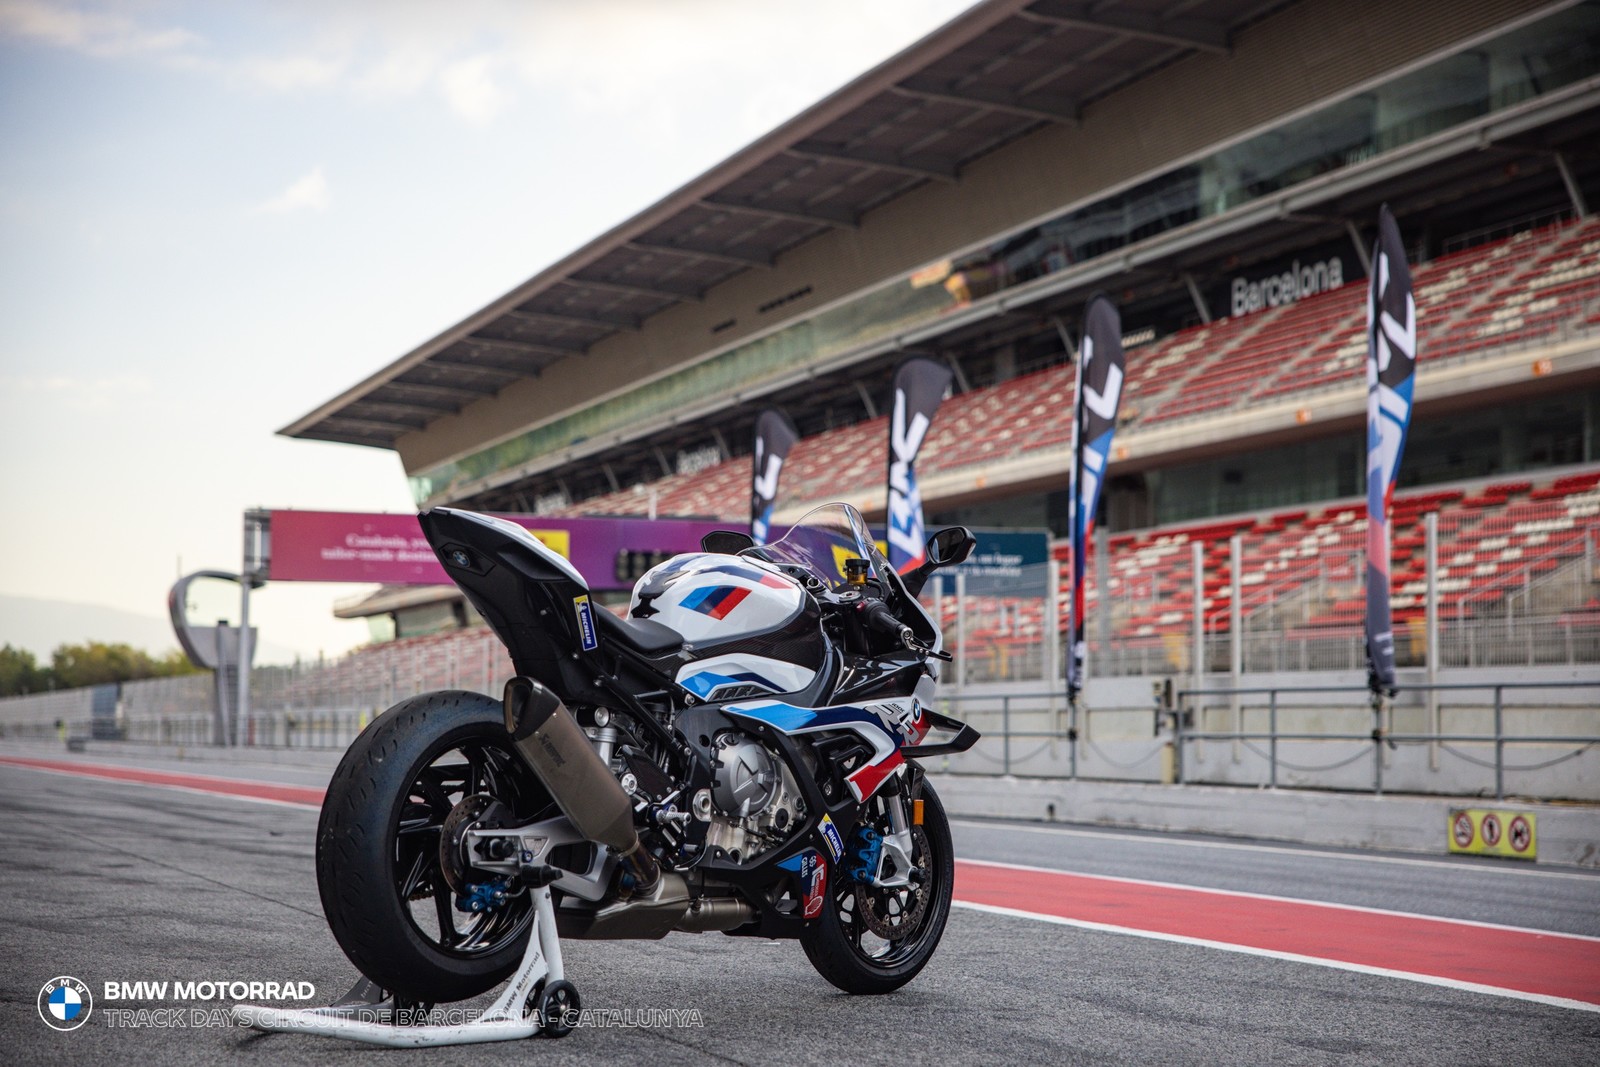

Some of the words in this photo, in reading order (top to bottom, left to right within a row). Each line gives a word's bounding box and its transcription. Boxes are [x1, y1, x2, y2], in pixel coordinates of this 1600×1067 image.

[1231, 257, 1344, 317] Barcelona
[580, 612, 592, 645] MICHELIN
[827, 829, 842, 858] MICHELIN
[516, 951, 540, 991] Motorrad
